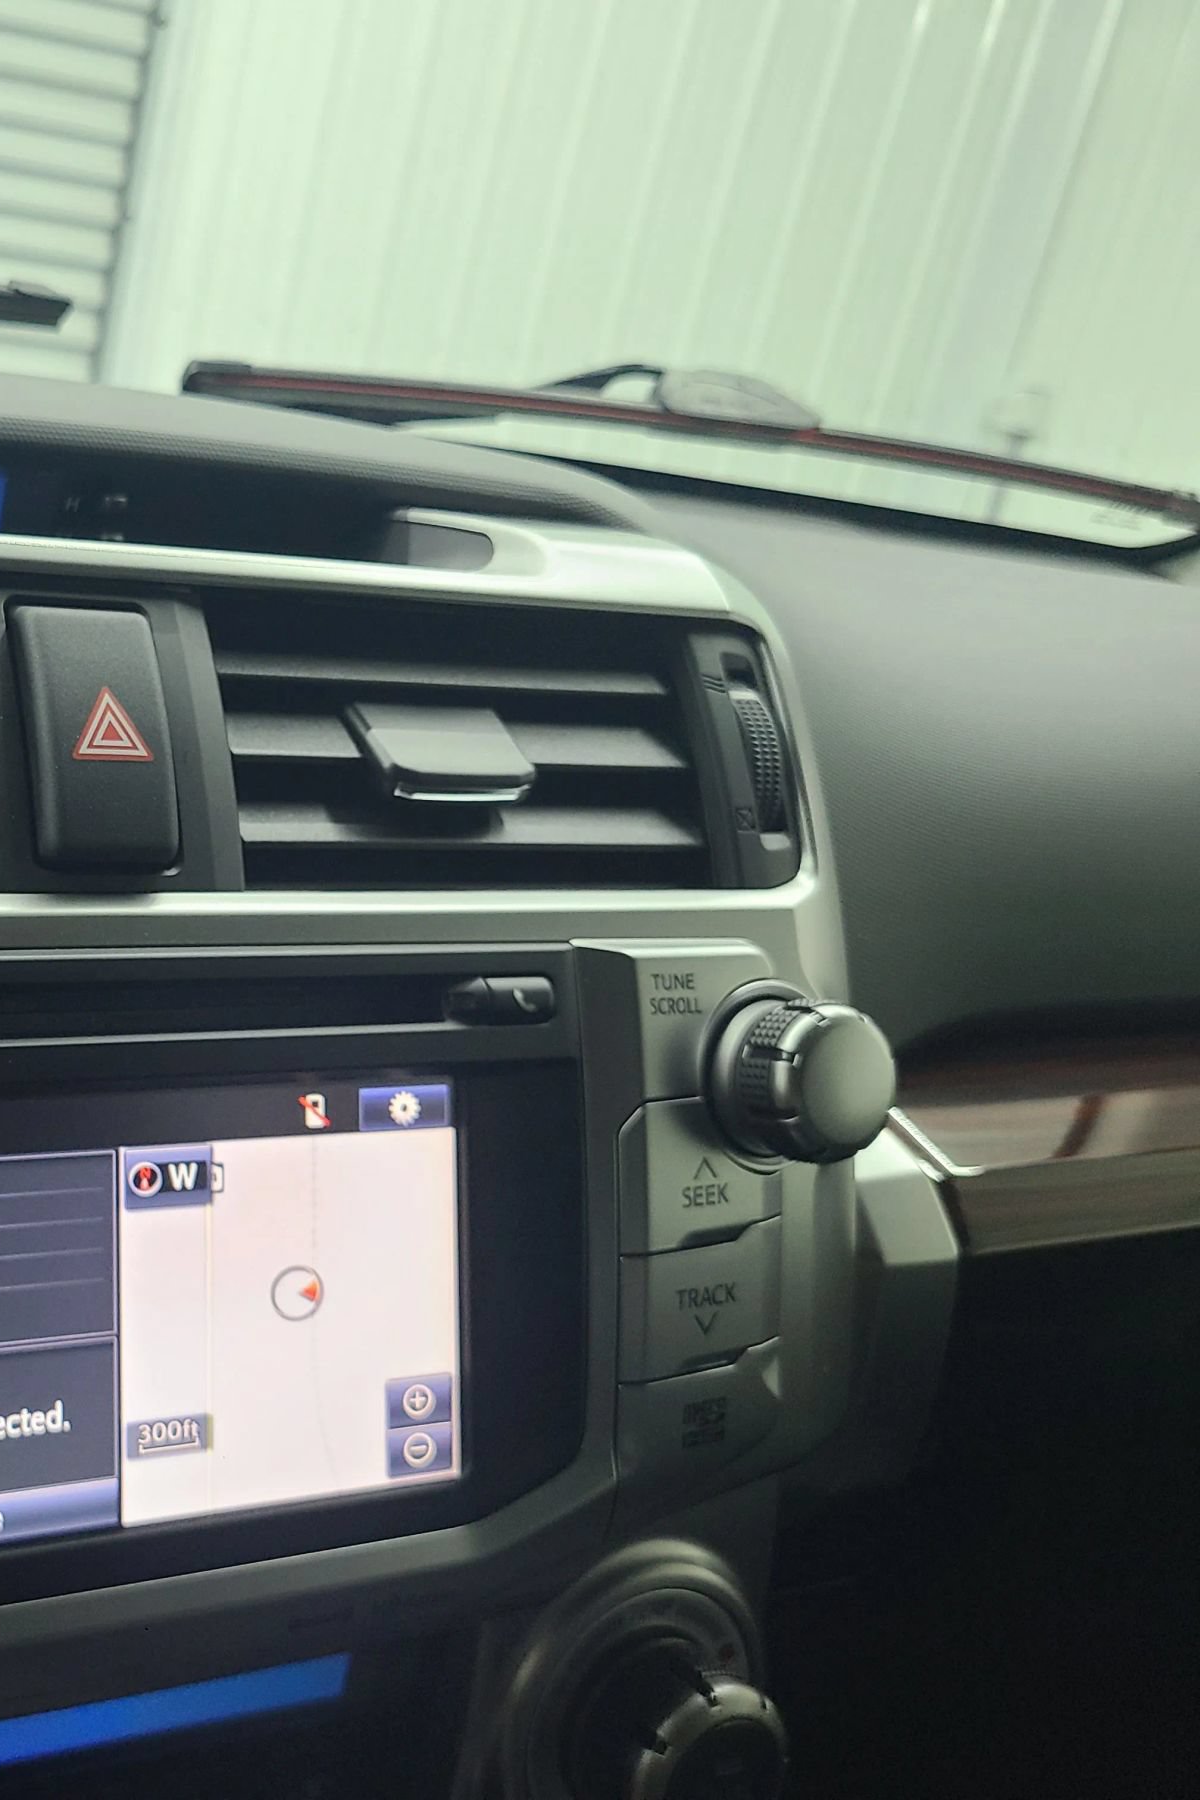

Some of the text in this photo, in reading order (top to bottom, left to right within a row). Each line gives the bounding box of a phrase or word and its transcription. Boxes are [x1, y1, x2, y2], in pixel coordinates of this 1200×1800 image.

[651, 973, 696, 991] TUNE
[649, 996, 702, 1015] SCROLL
[167, 1162, 199, 1191] W
[681, 1182, 729, 1208] SEEK
[676, 1282, 737, 1310] TRACK
[137, 1417, 201, 1445] 300ft
